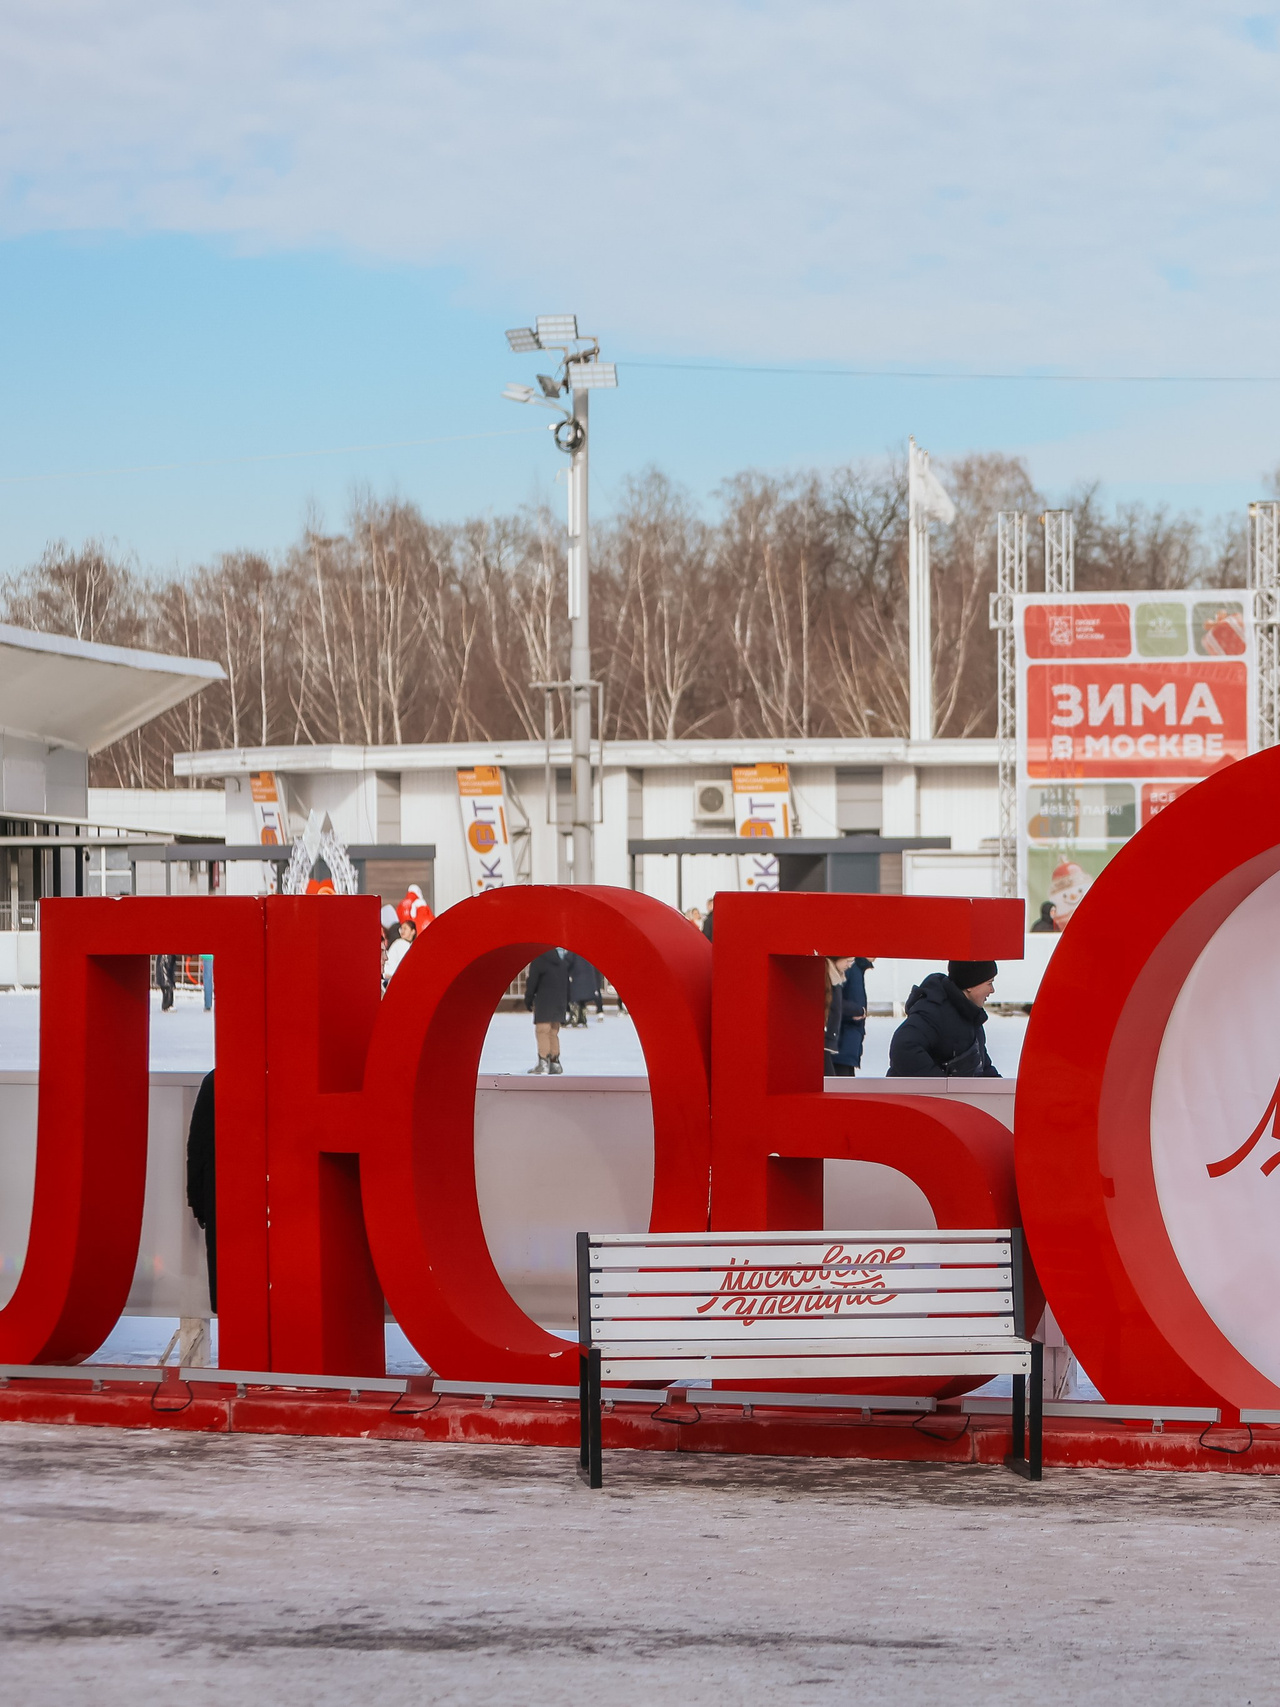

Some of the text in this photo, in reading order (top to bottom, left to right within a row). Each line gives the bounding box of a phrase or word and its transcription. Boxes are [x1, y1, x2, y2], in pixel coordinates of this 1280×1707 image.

[1051, 682, 1224, 728] ЗИМА
[1051, 733, 1224, 759] В МОСКВЕ
[696, 1245, 906, 1313] Московское
